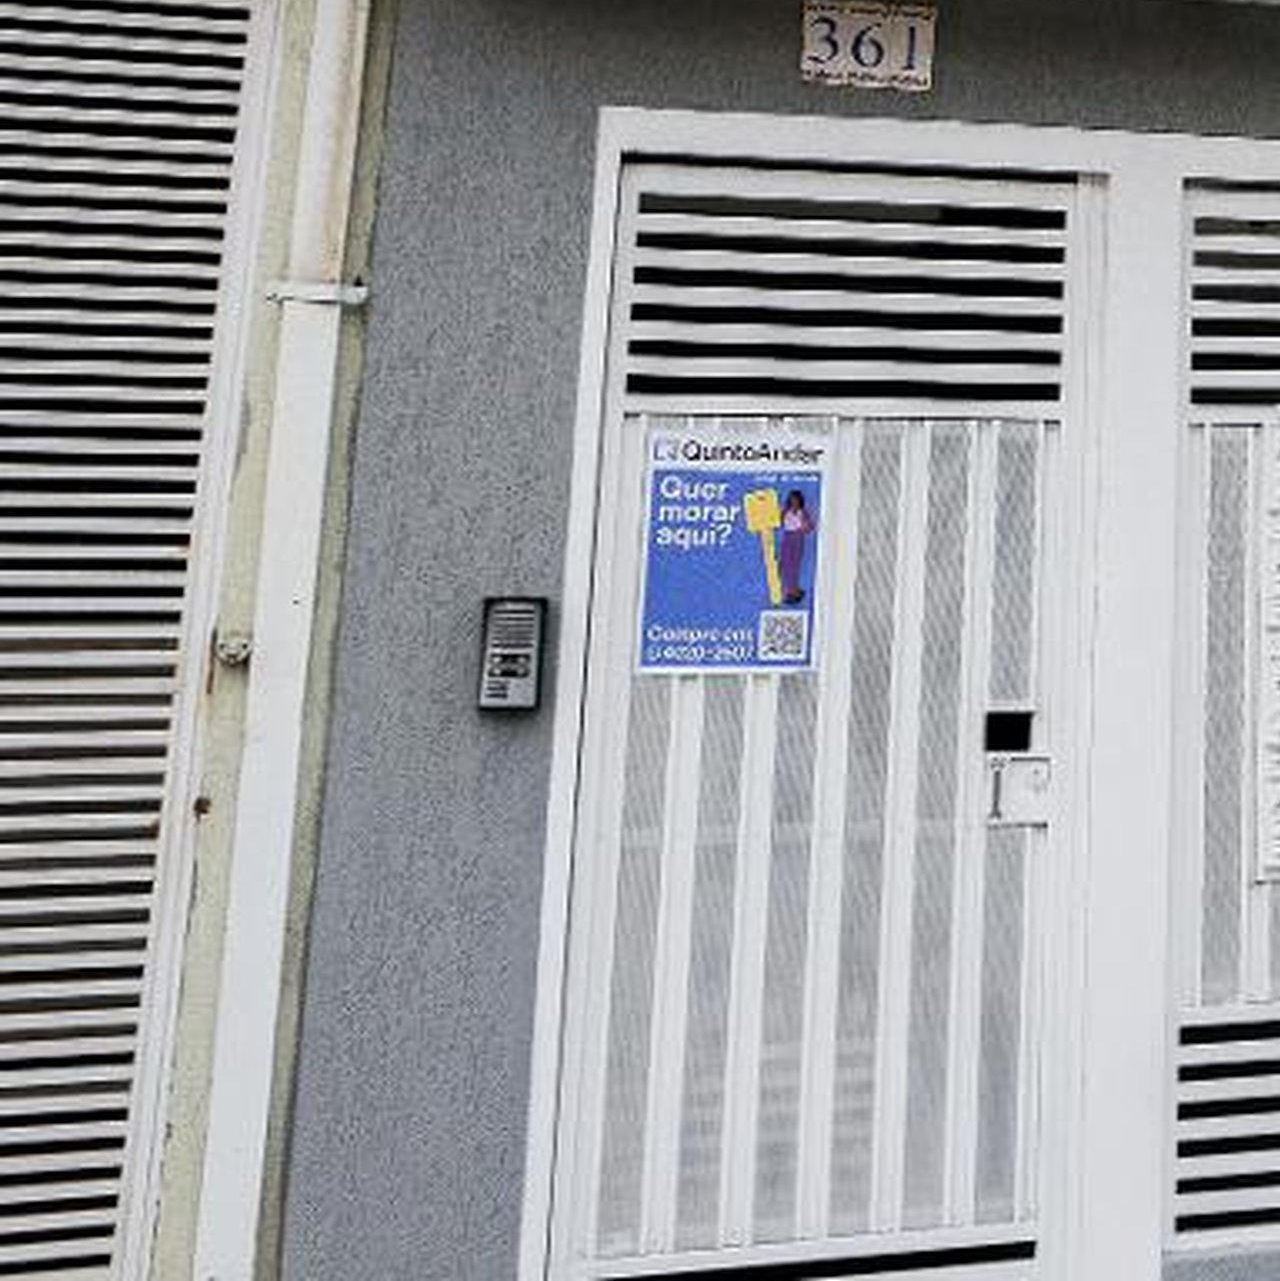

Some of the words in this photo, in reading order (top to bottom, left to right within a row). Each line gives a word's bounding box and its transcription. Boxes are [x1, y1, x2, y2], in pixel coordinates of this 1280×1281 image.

[807, 16, 917, 71] 361
[660, 475, 729, 500] Quer
[659, 505, 741, 522] morar
[656, 523, 732, 550] aqui?
